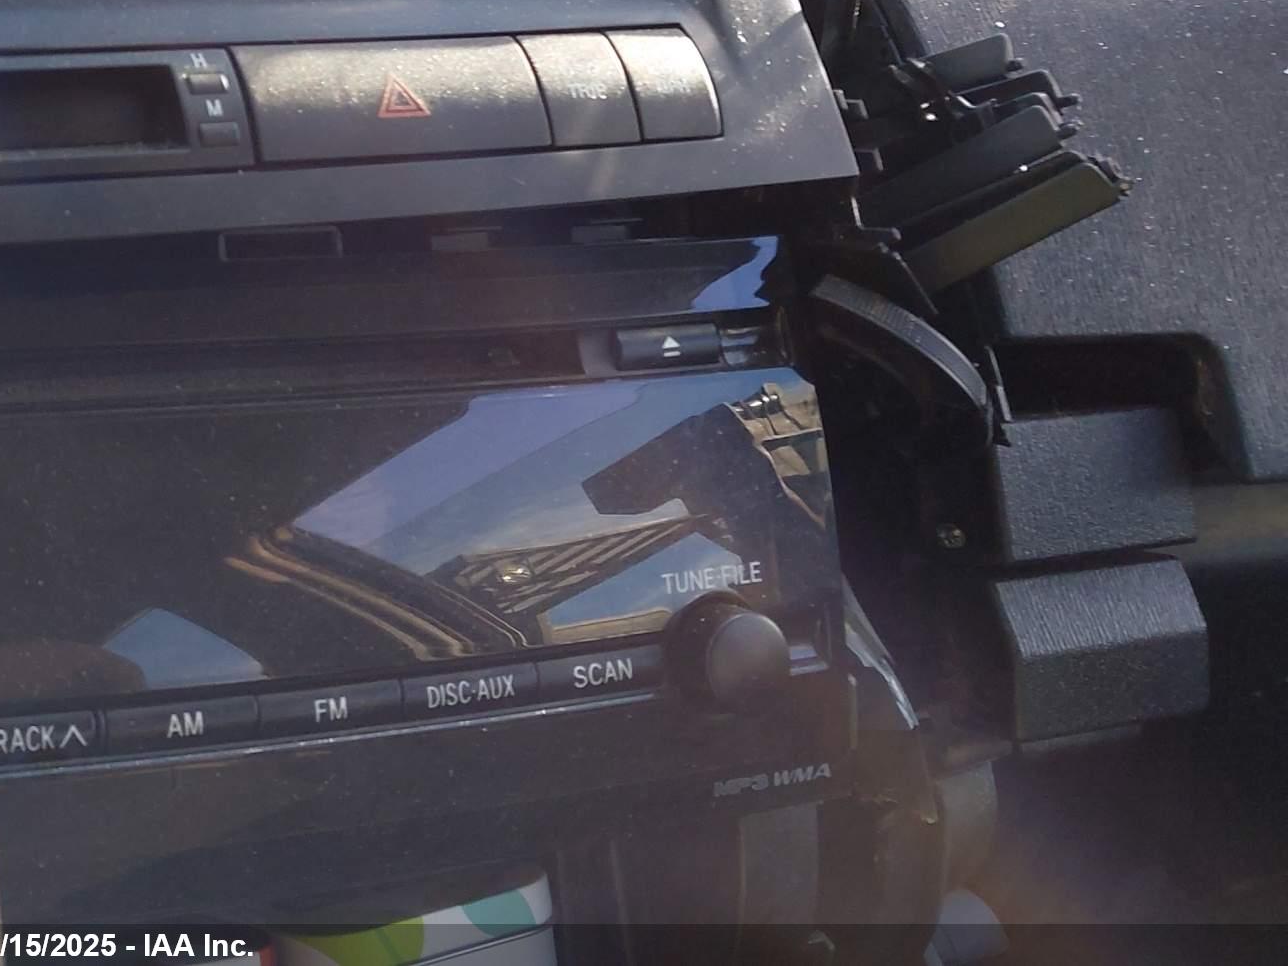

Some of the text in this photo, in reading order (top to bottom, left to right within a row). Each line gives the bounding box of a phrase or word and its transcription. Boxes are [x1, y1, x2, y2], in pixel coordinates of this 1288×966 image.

[190, 53, 207, 68] H
[205, 98, 223, 117] M
[573, 658, 634, 689] SCAN
[314, 696, 348, 724] FM
[167, 710, 205, 739] AM
[773, 763, 832, 787] WMA
